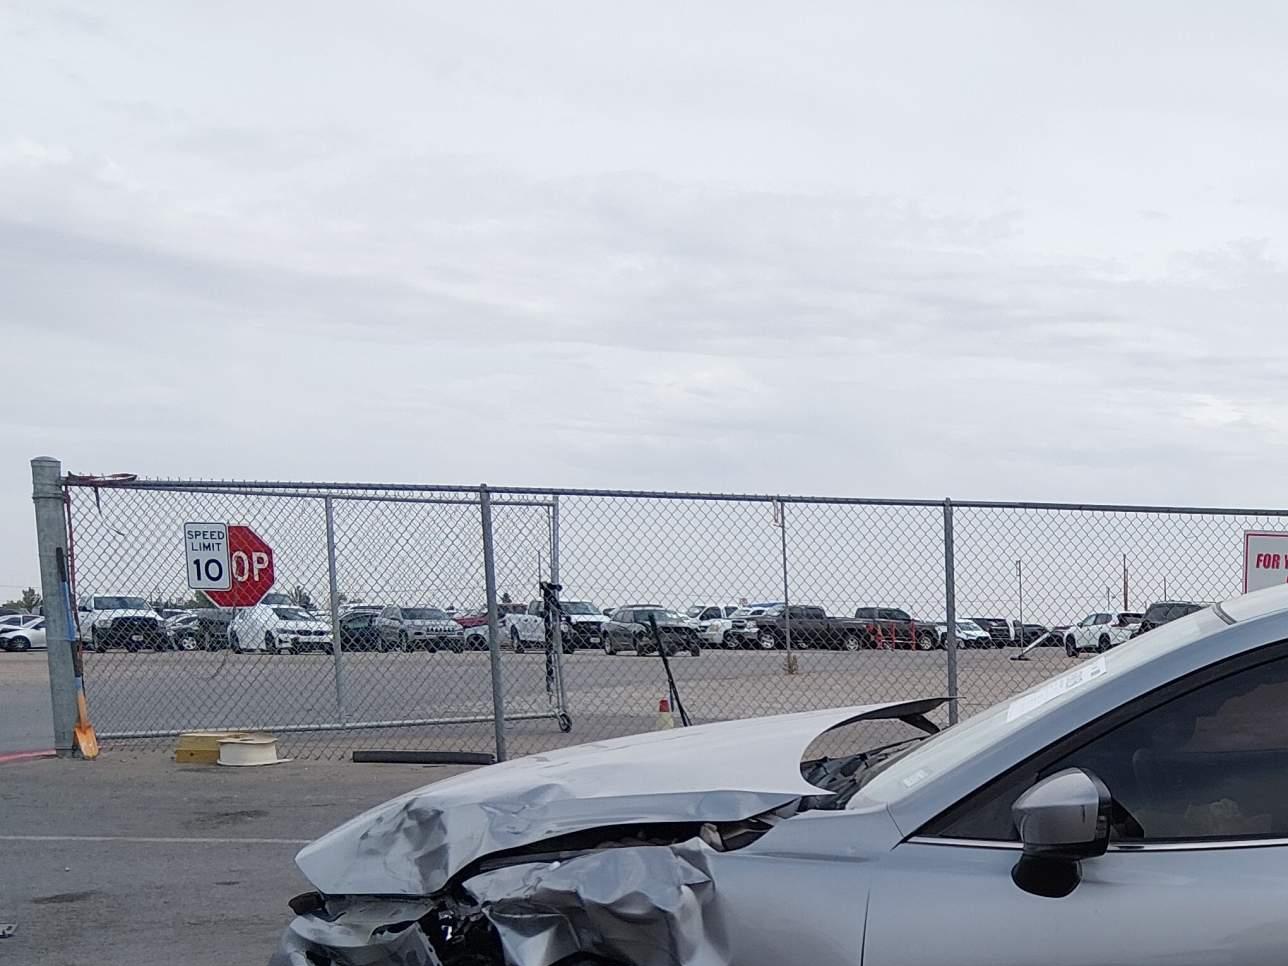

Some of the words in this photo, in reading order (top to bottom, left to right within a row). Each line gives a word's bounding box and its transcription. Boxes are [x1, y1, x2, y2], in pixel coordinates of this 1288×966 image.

[187, 530, 225, 540] SPEED
[191, 542, 222, 551] LIMIT
[231, 550, 269, 582] OP
[1256, 553, 1281, 569] FOR
[193, 558, 223, 581] 10
